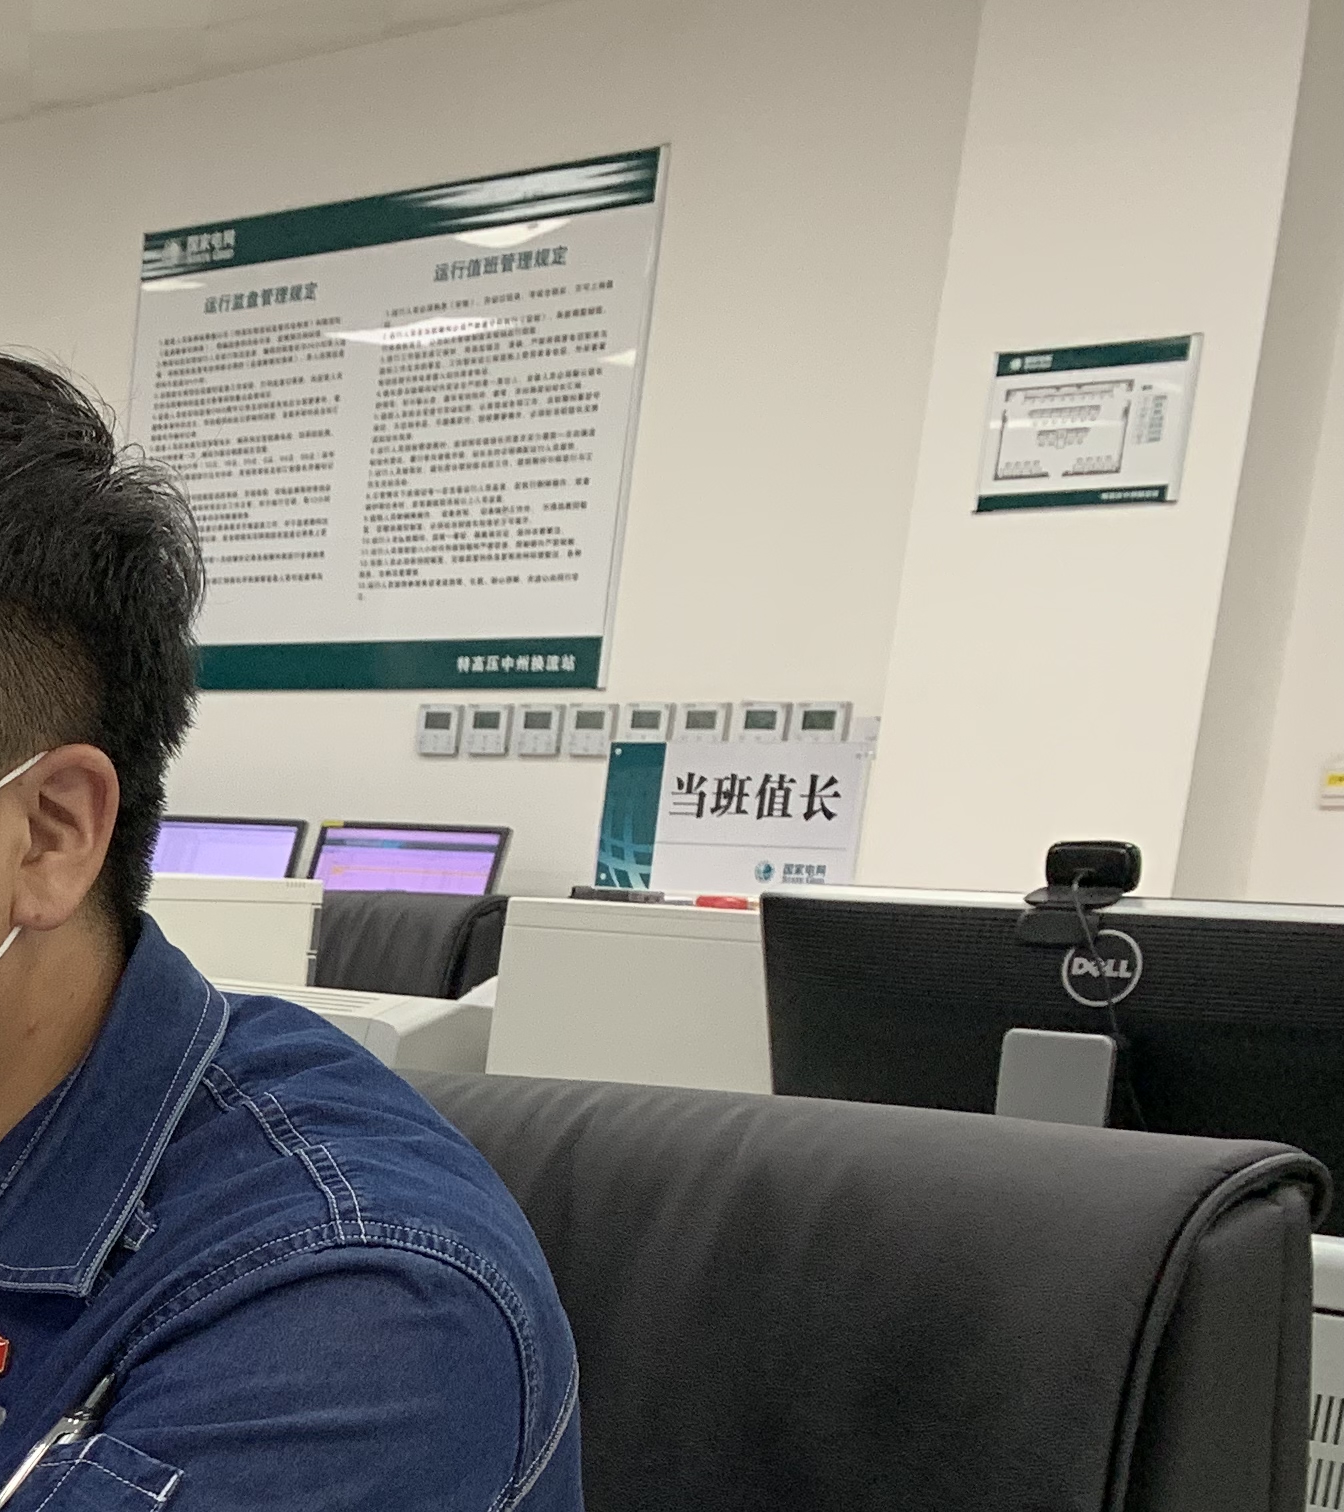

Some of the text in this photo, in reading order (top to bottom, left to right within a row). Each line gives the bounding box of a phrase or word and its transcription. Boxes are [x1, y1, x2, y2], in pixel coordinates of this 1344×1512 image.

[669, 772, 842, 821] 当班值长
[782, 863, 827, 877] 国家电网
